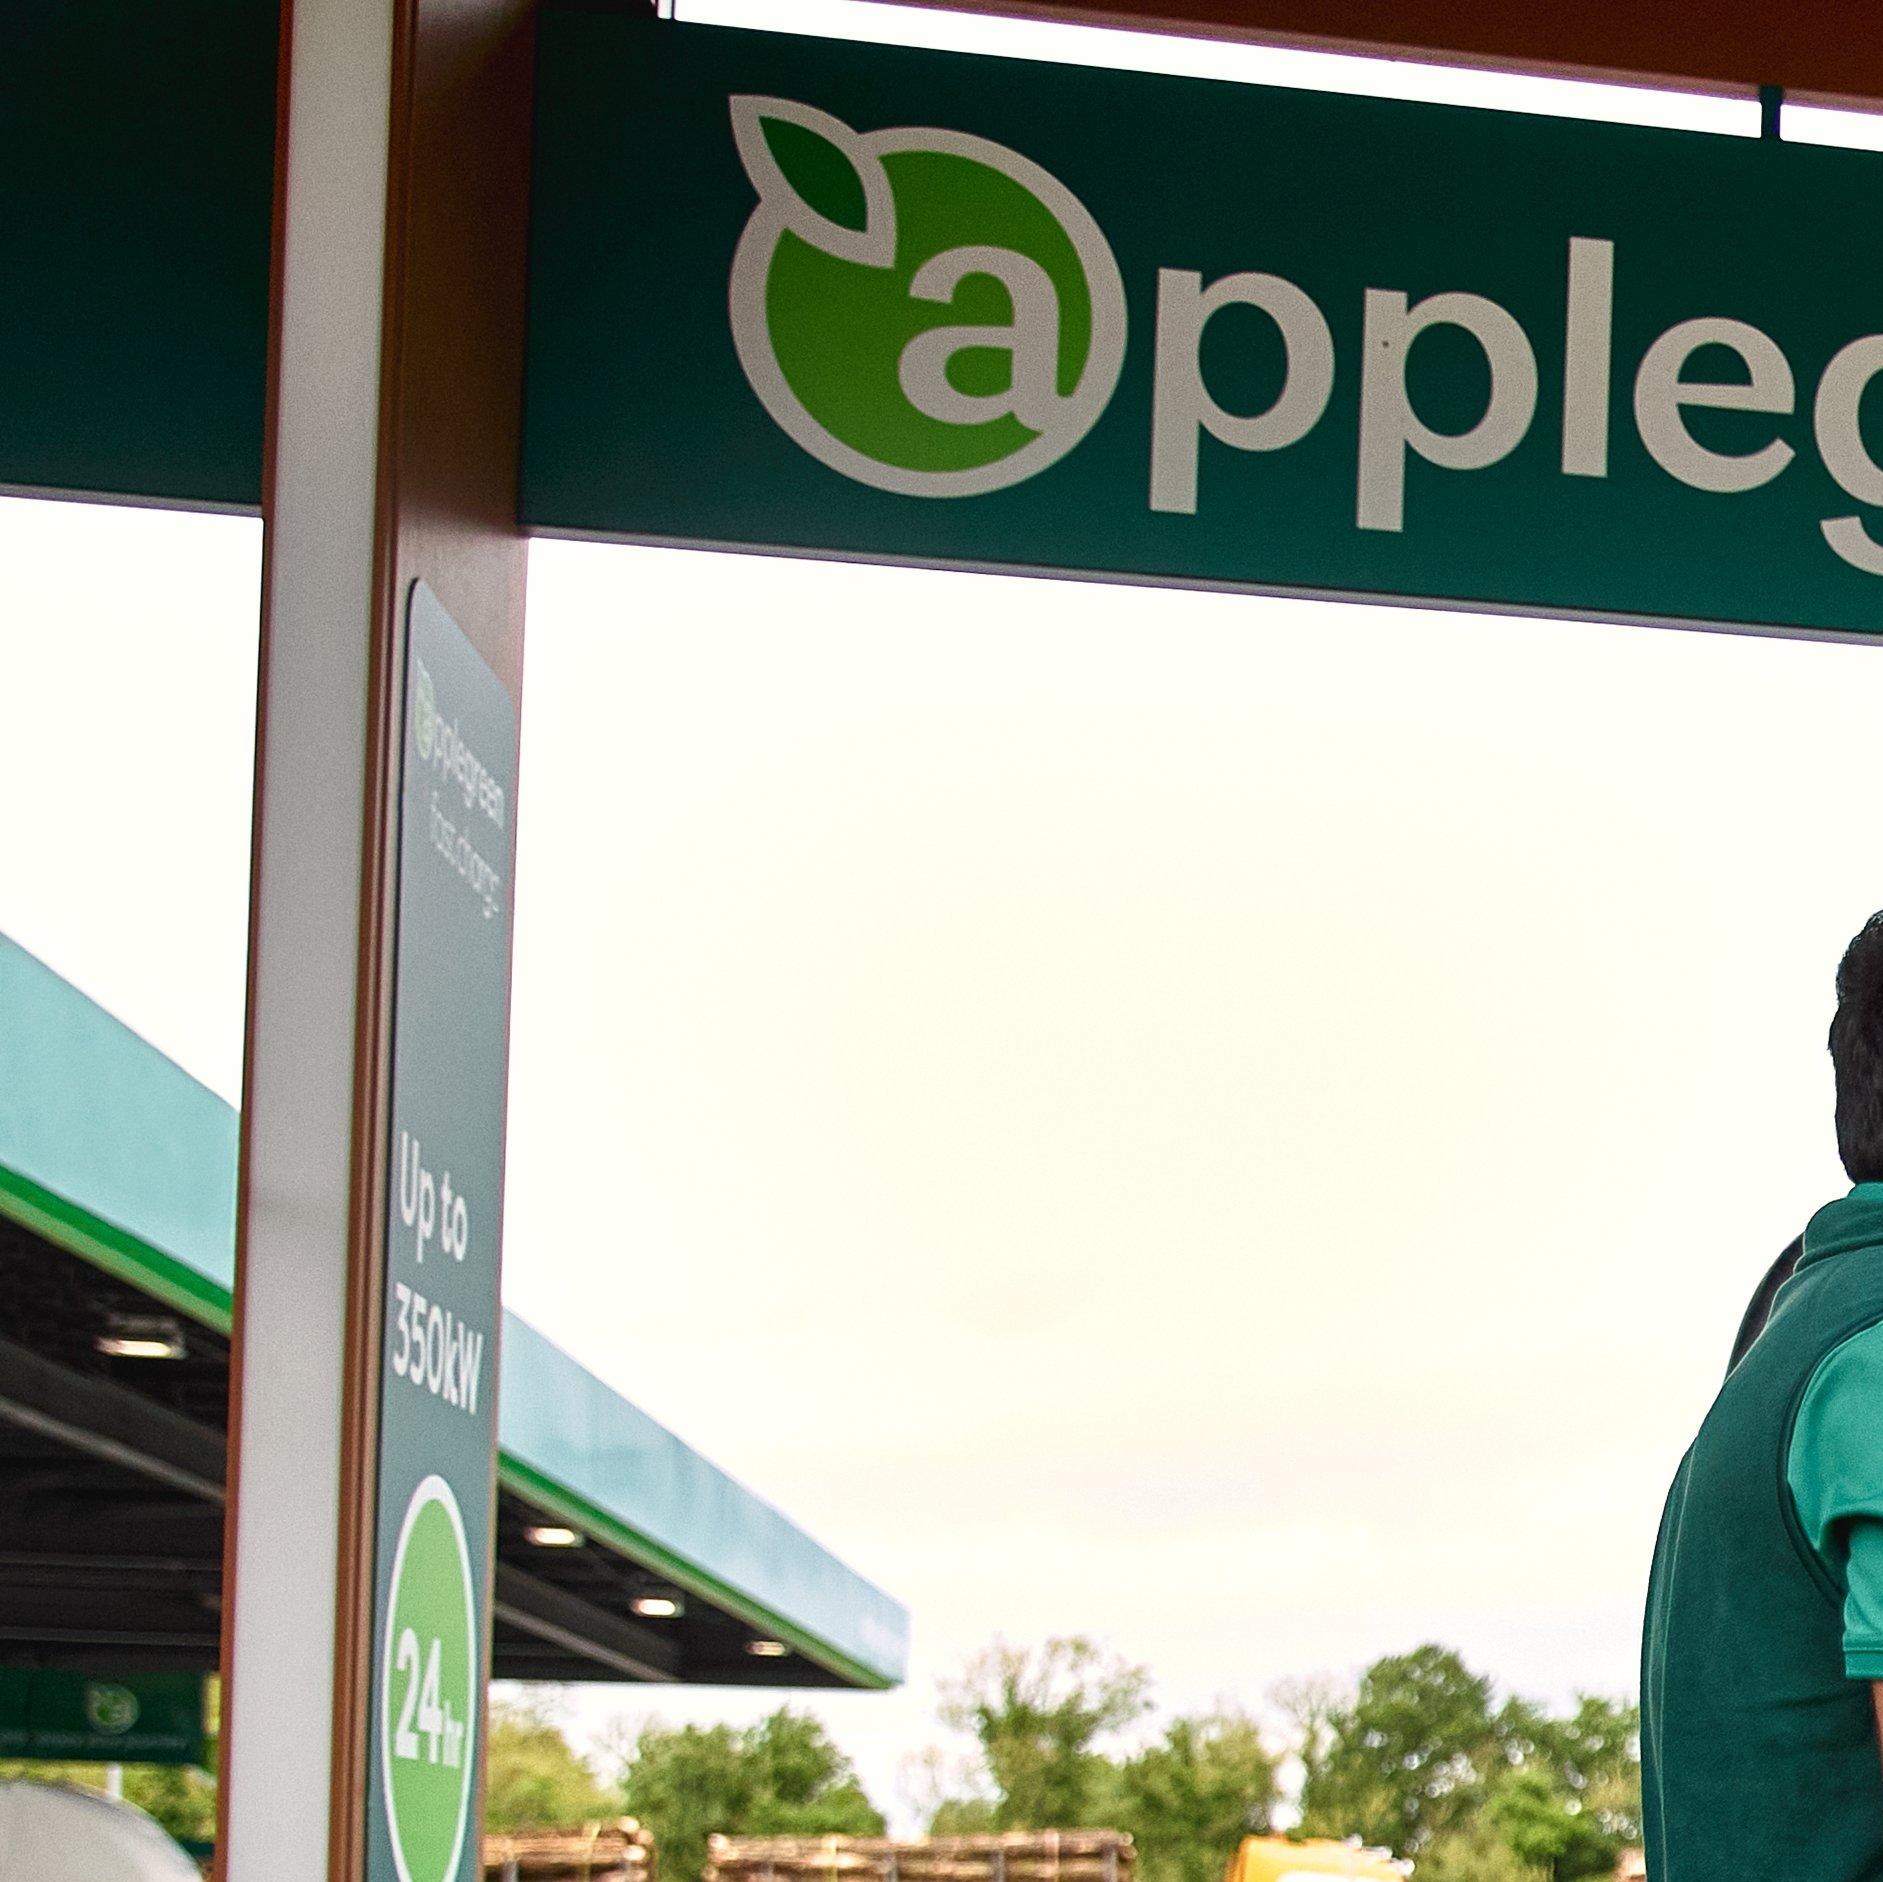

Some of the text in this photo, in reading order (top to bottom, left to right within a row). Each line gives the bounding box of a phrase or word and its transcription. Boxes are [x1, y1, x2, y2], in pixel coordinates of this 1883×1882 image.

[400, 1129, 470, 1265] Up to
[392, 1281, 485, 1416] 350kW
[395, 1627, 464, 1769] 24hr
